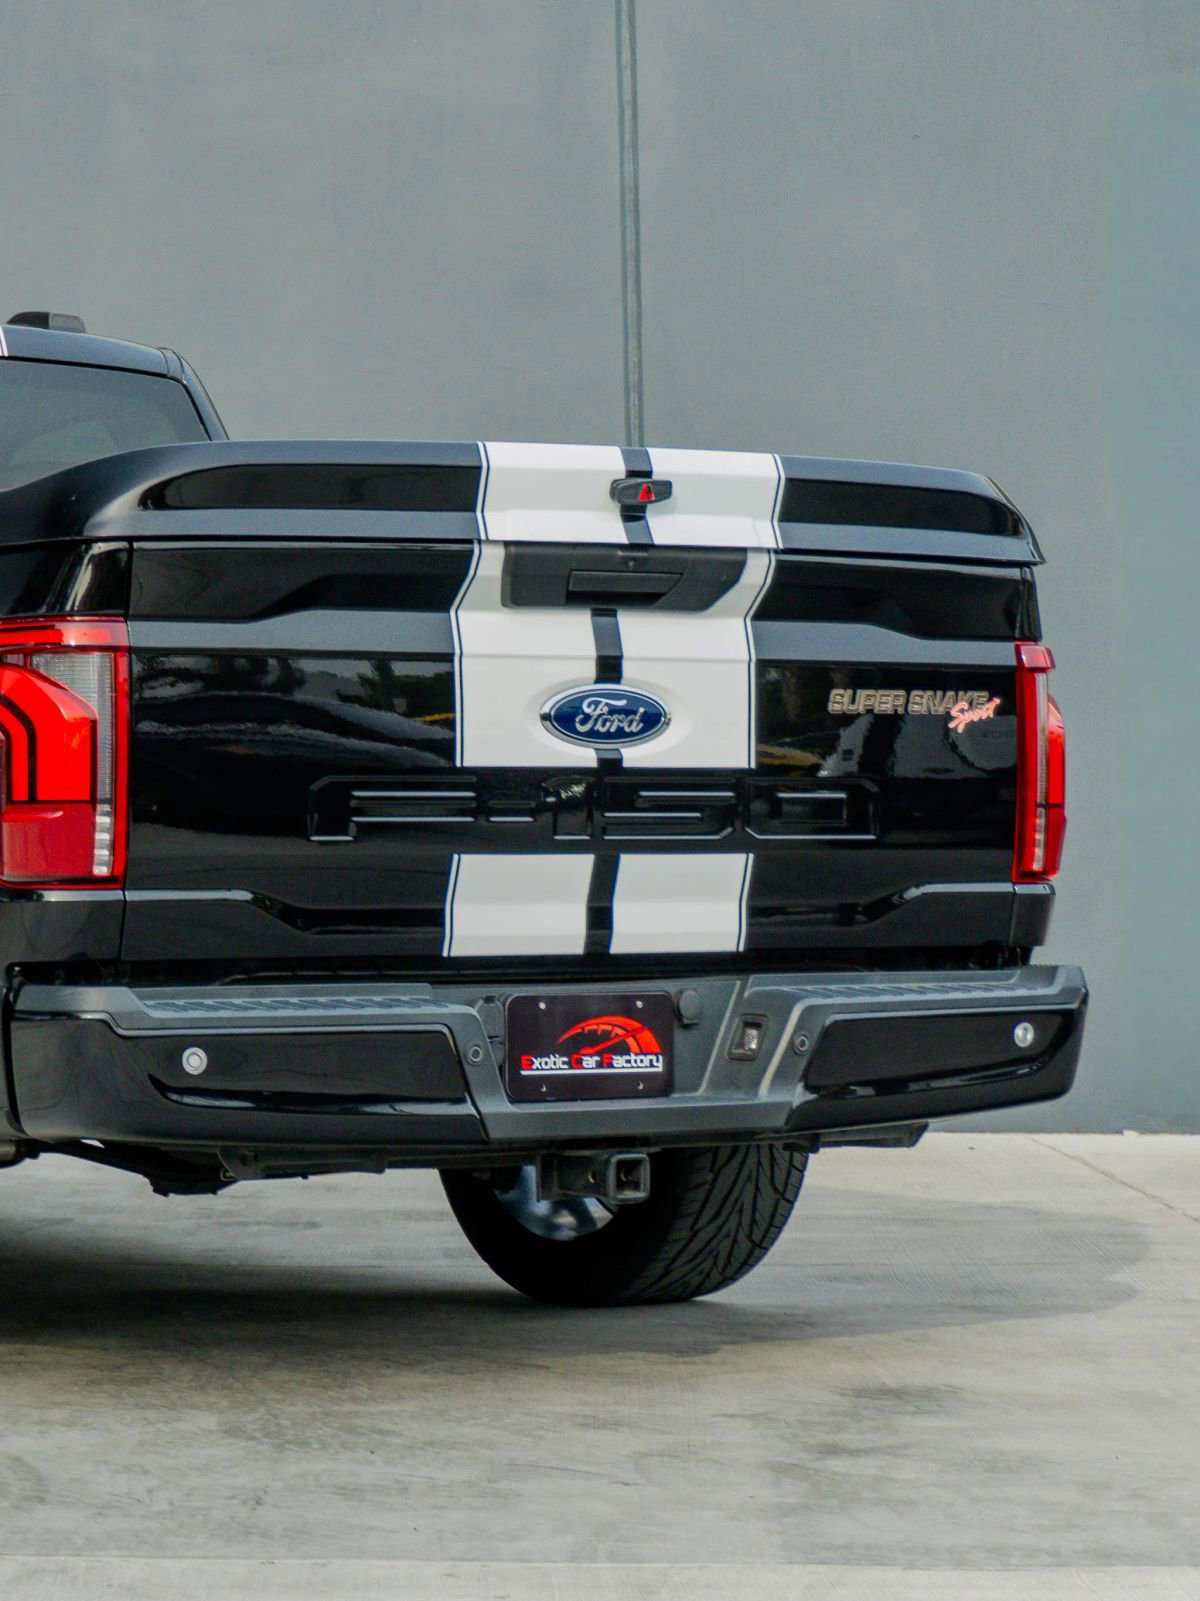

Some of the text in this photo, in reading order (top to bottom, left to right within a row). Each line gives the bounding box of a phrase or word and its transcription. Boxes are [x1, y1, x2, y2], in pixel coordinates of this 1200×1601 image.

[575, 697, 645, 733] Ford
[828, 688, 907, 715] SUPER
[307, 774, 880, 842] F-150
[520, 1052, 663, 1072] Exotic Car Factory
